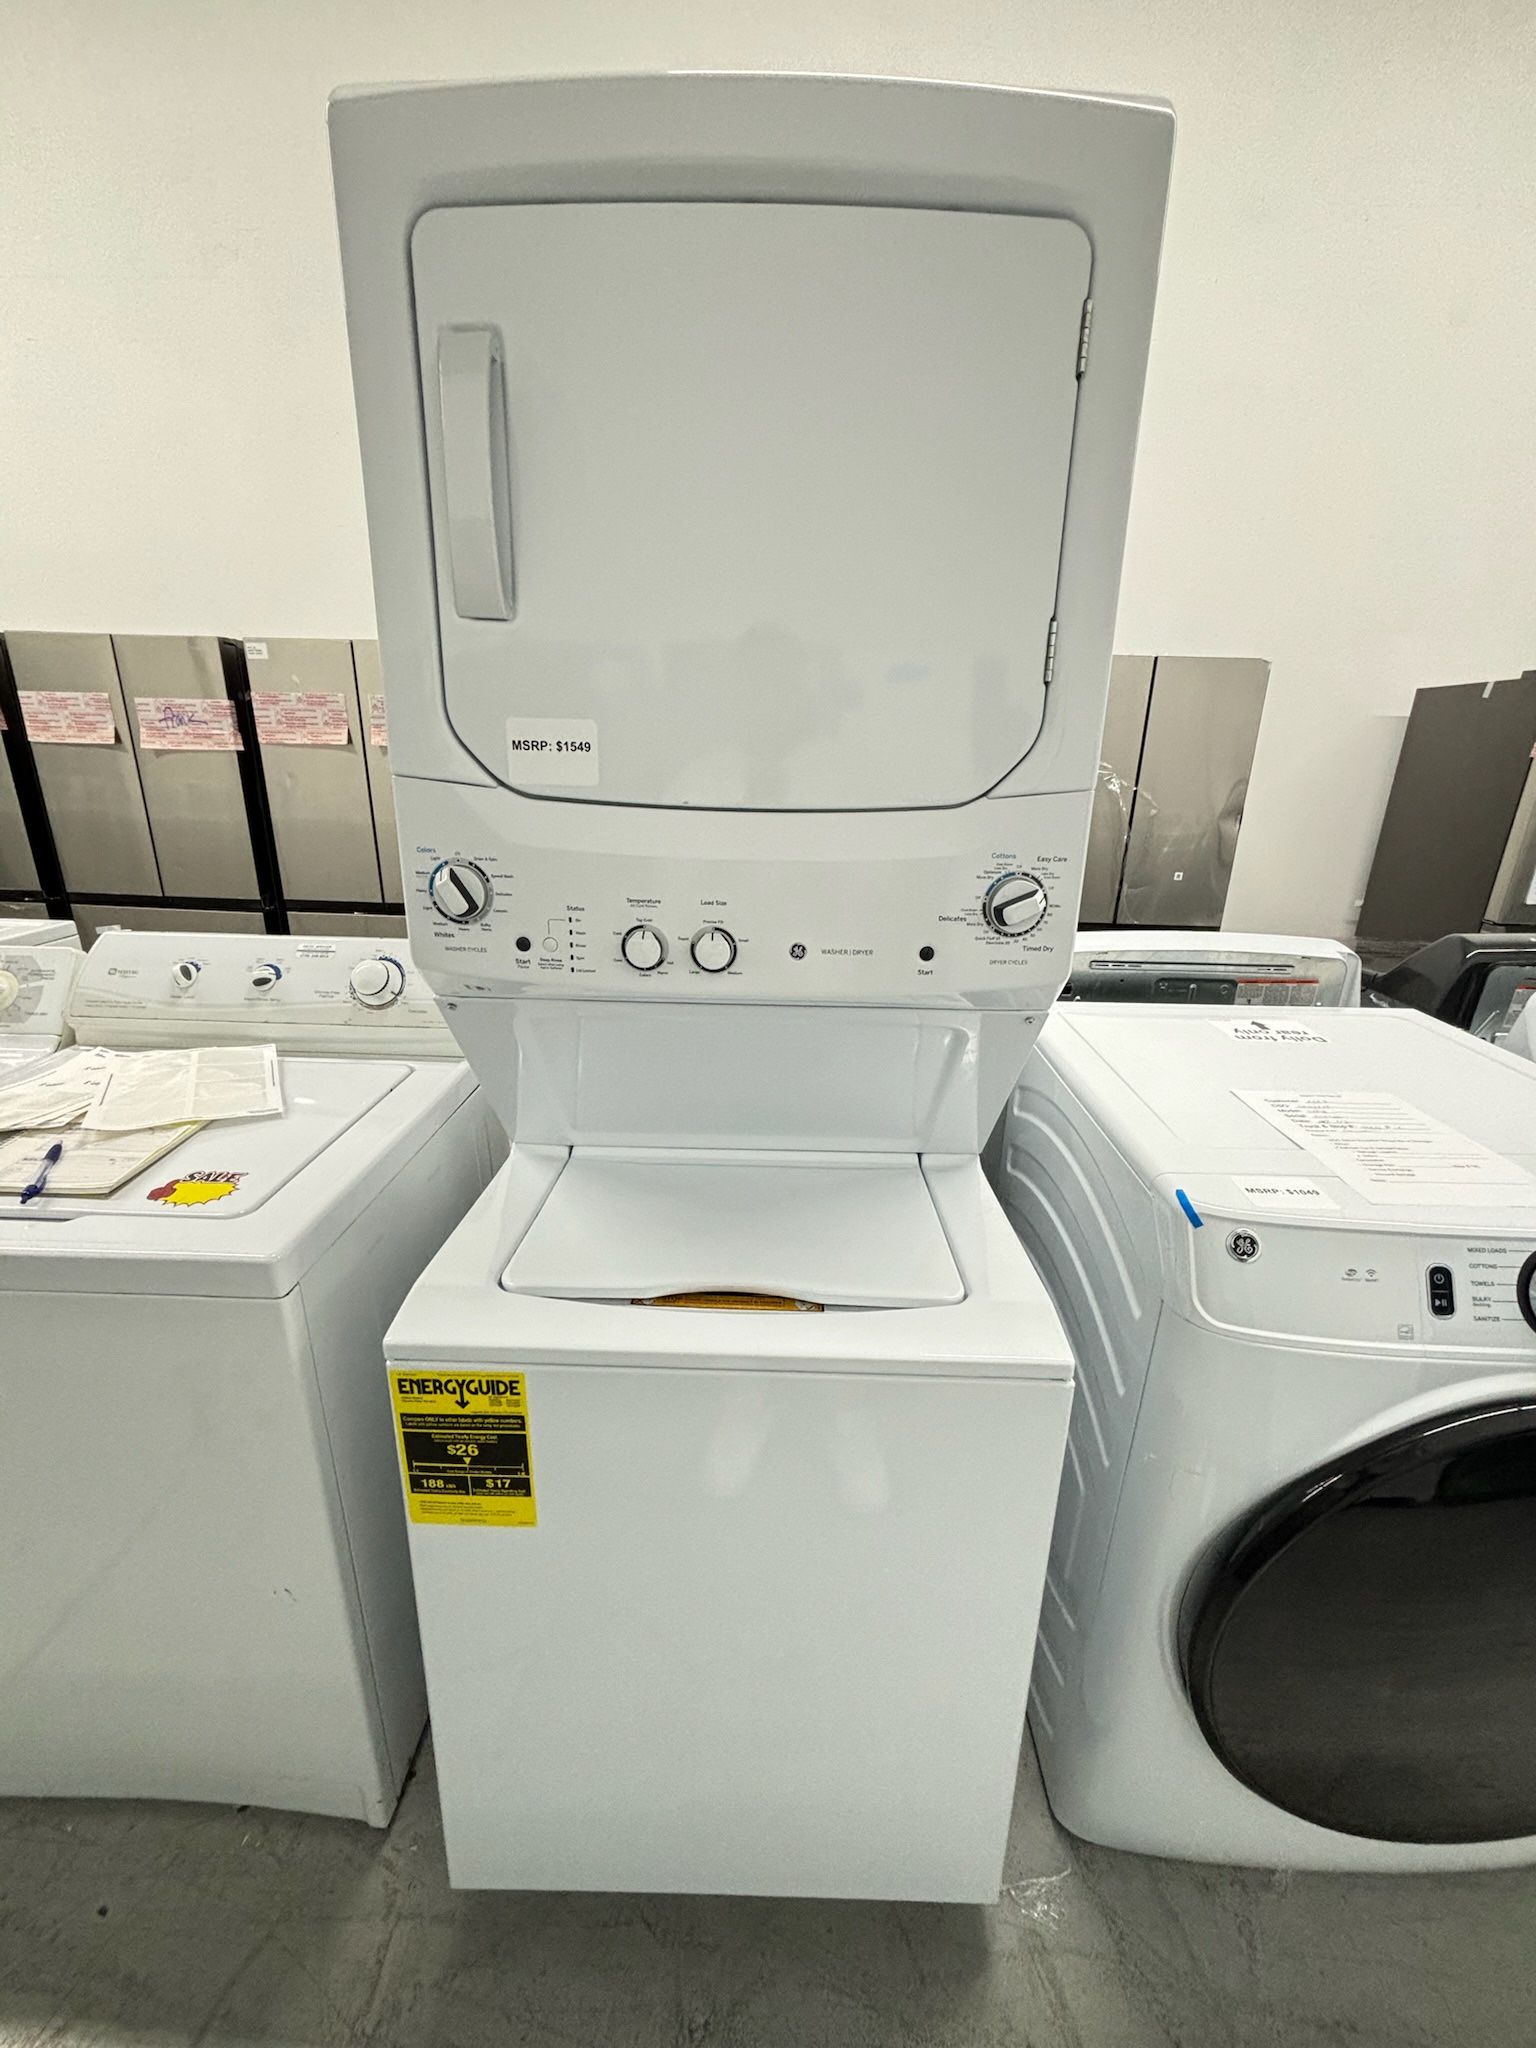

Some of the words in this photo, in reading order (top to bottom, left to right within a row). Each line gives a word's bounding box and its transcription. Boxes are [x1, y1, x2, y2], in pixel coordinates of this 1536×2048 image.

[511, 739, 552, 752] MSRP:
[556, 740, 591, 753] $1549
[627, 897, 662, 905] Temperature
[1042, 945, 1054, 953] Dry
[1281, 1035, 1329, 1043] Dolly
[1244, 1187, 1285, 1195] MSRP:
[1286, 1188, 1320, 1196] $1049
[397, 1378, 521, 1400] ENERGYGUIDE
[446, 1444, 479, 1456] $26
[421, 1479, 445, 1489] 188
[485, 1479, 511, 1489] $17
